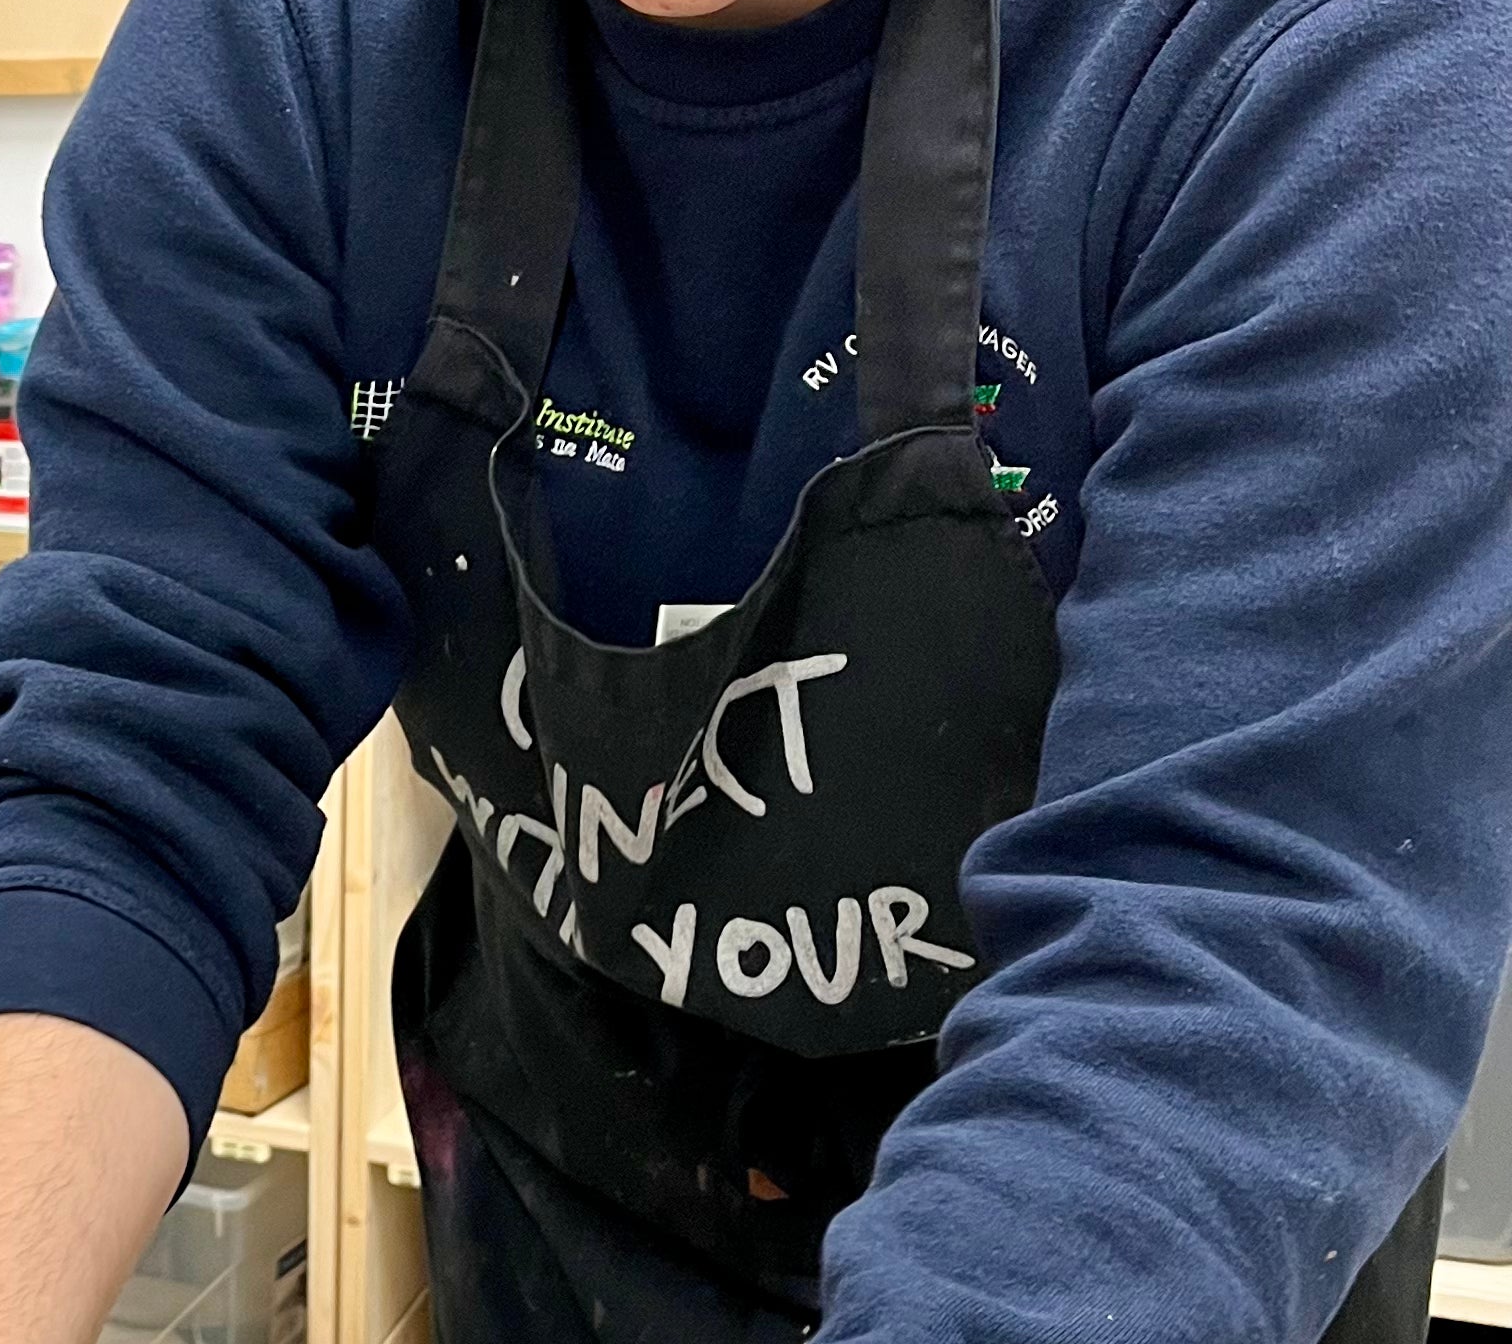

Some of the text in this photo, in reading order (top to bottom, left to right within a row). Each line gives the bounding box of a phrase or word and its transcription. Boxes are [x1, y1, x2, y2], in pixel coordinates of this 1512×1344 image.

[802, 324, 1038, 391] RV YAGER
[631, 885, 976, 1007] YOUR
